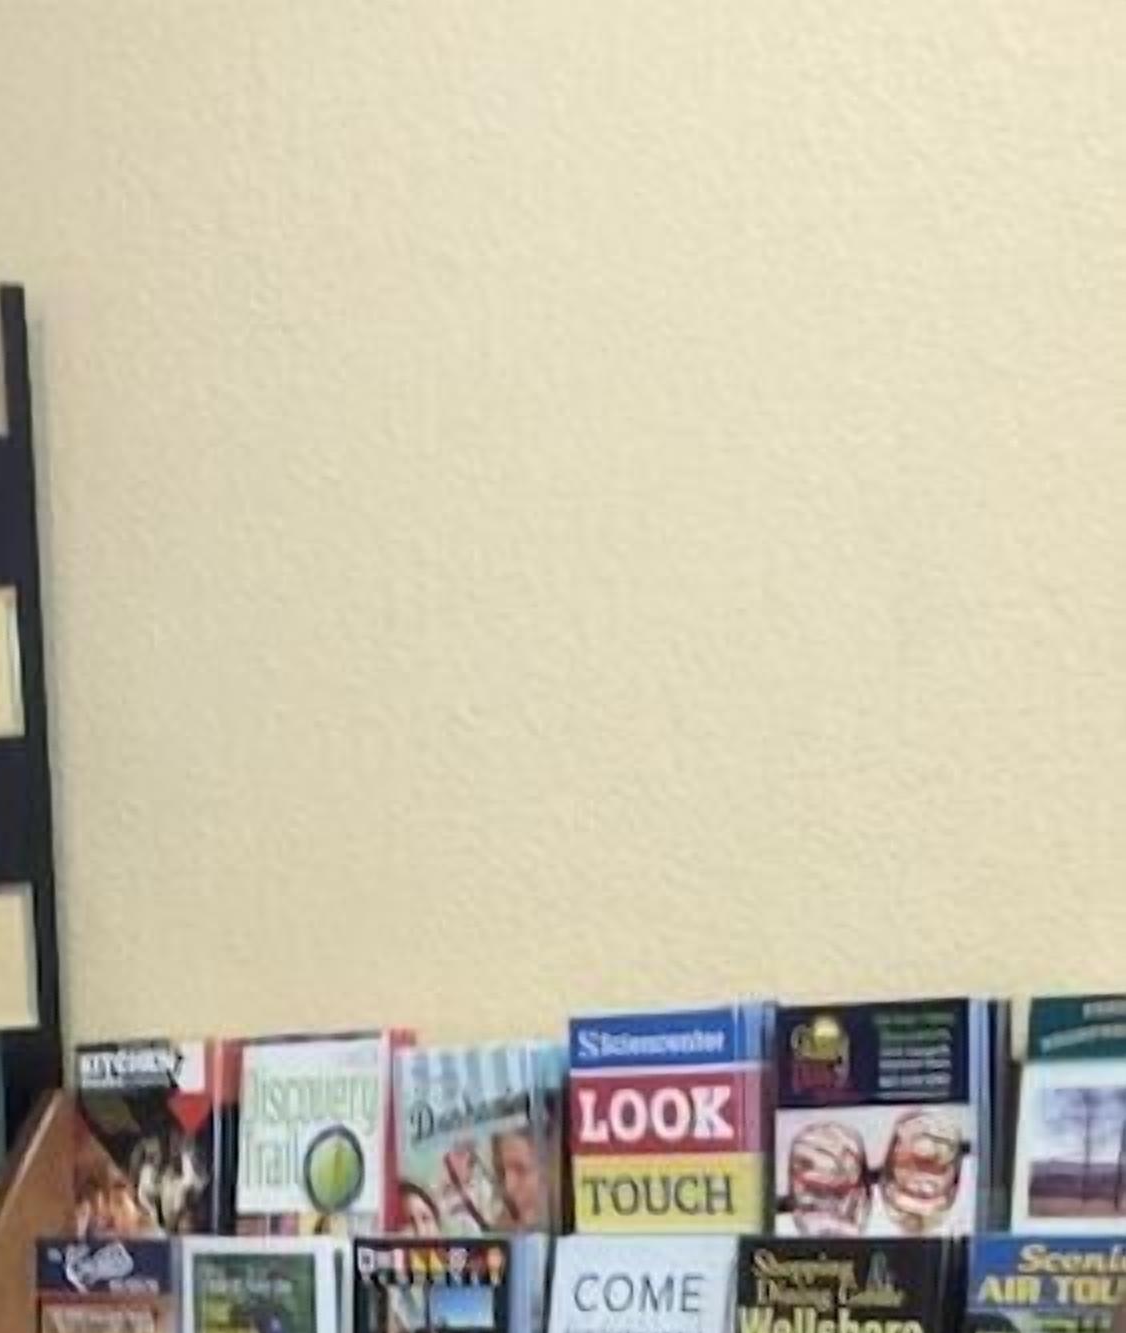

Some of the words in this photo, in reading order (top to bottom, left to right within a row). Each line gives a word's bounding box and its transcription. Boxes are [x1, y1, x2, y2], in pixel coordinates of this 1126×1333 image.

[578, 1085, 735, 1143] LOOK
[582, 1173, 736, 1216] TOUCH
[573, 1272, 706, 1313] COME
[977, 1275, 1041, 1304] AIR
[1052, 1276, 1126, 1305] TOU
